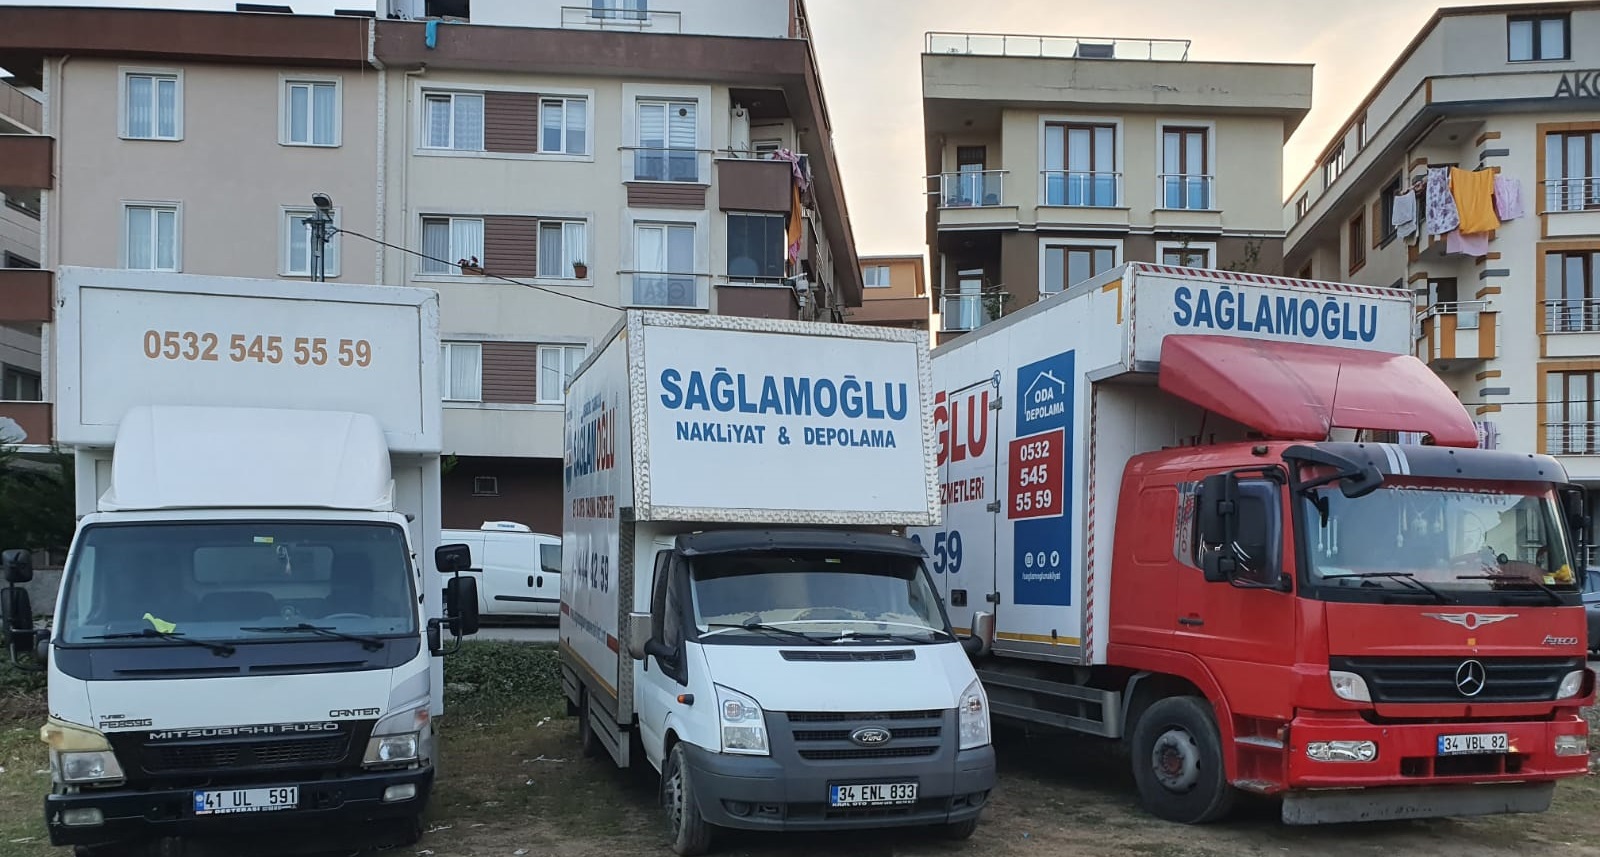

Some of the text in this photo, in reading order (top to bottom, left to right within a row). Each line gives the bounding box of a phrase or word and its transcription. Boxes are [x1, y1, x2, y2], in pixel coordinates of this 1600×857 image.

[1173, 285, 1378, 343] SAĞLAMOĞLU
[143, 330, 371, 367] 0532 545 55 59
[660, 367, 908, 421] SAĞLAMOĞLU
[1034, 387, 1054, 404] ODA
[1026, 401, 1065, 422] DEPOLAMA
[778, 426, 791, 446] &
[804, 427, 897, 449] DEPOLAMA
[1020, 440, 1049, 462] 0532
[1020, 464, 1047, 487] 545
[1016, 489, 1052, 512] 55 59
[933, 530, 963, 575] 59
[600, 554, 609, 595] 59
[329, 707, 381, 718] CANTER
[149, 722, 339, 740] MITSUBISHI FUSO
[863, 731, 882, 741] Ford
[1444, 735, 1505, 750] 34 VBL 82
[205, 788, 296, 808] 41 UL 591
[840, 785, 914, 801] 34 ENL 833
